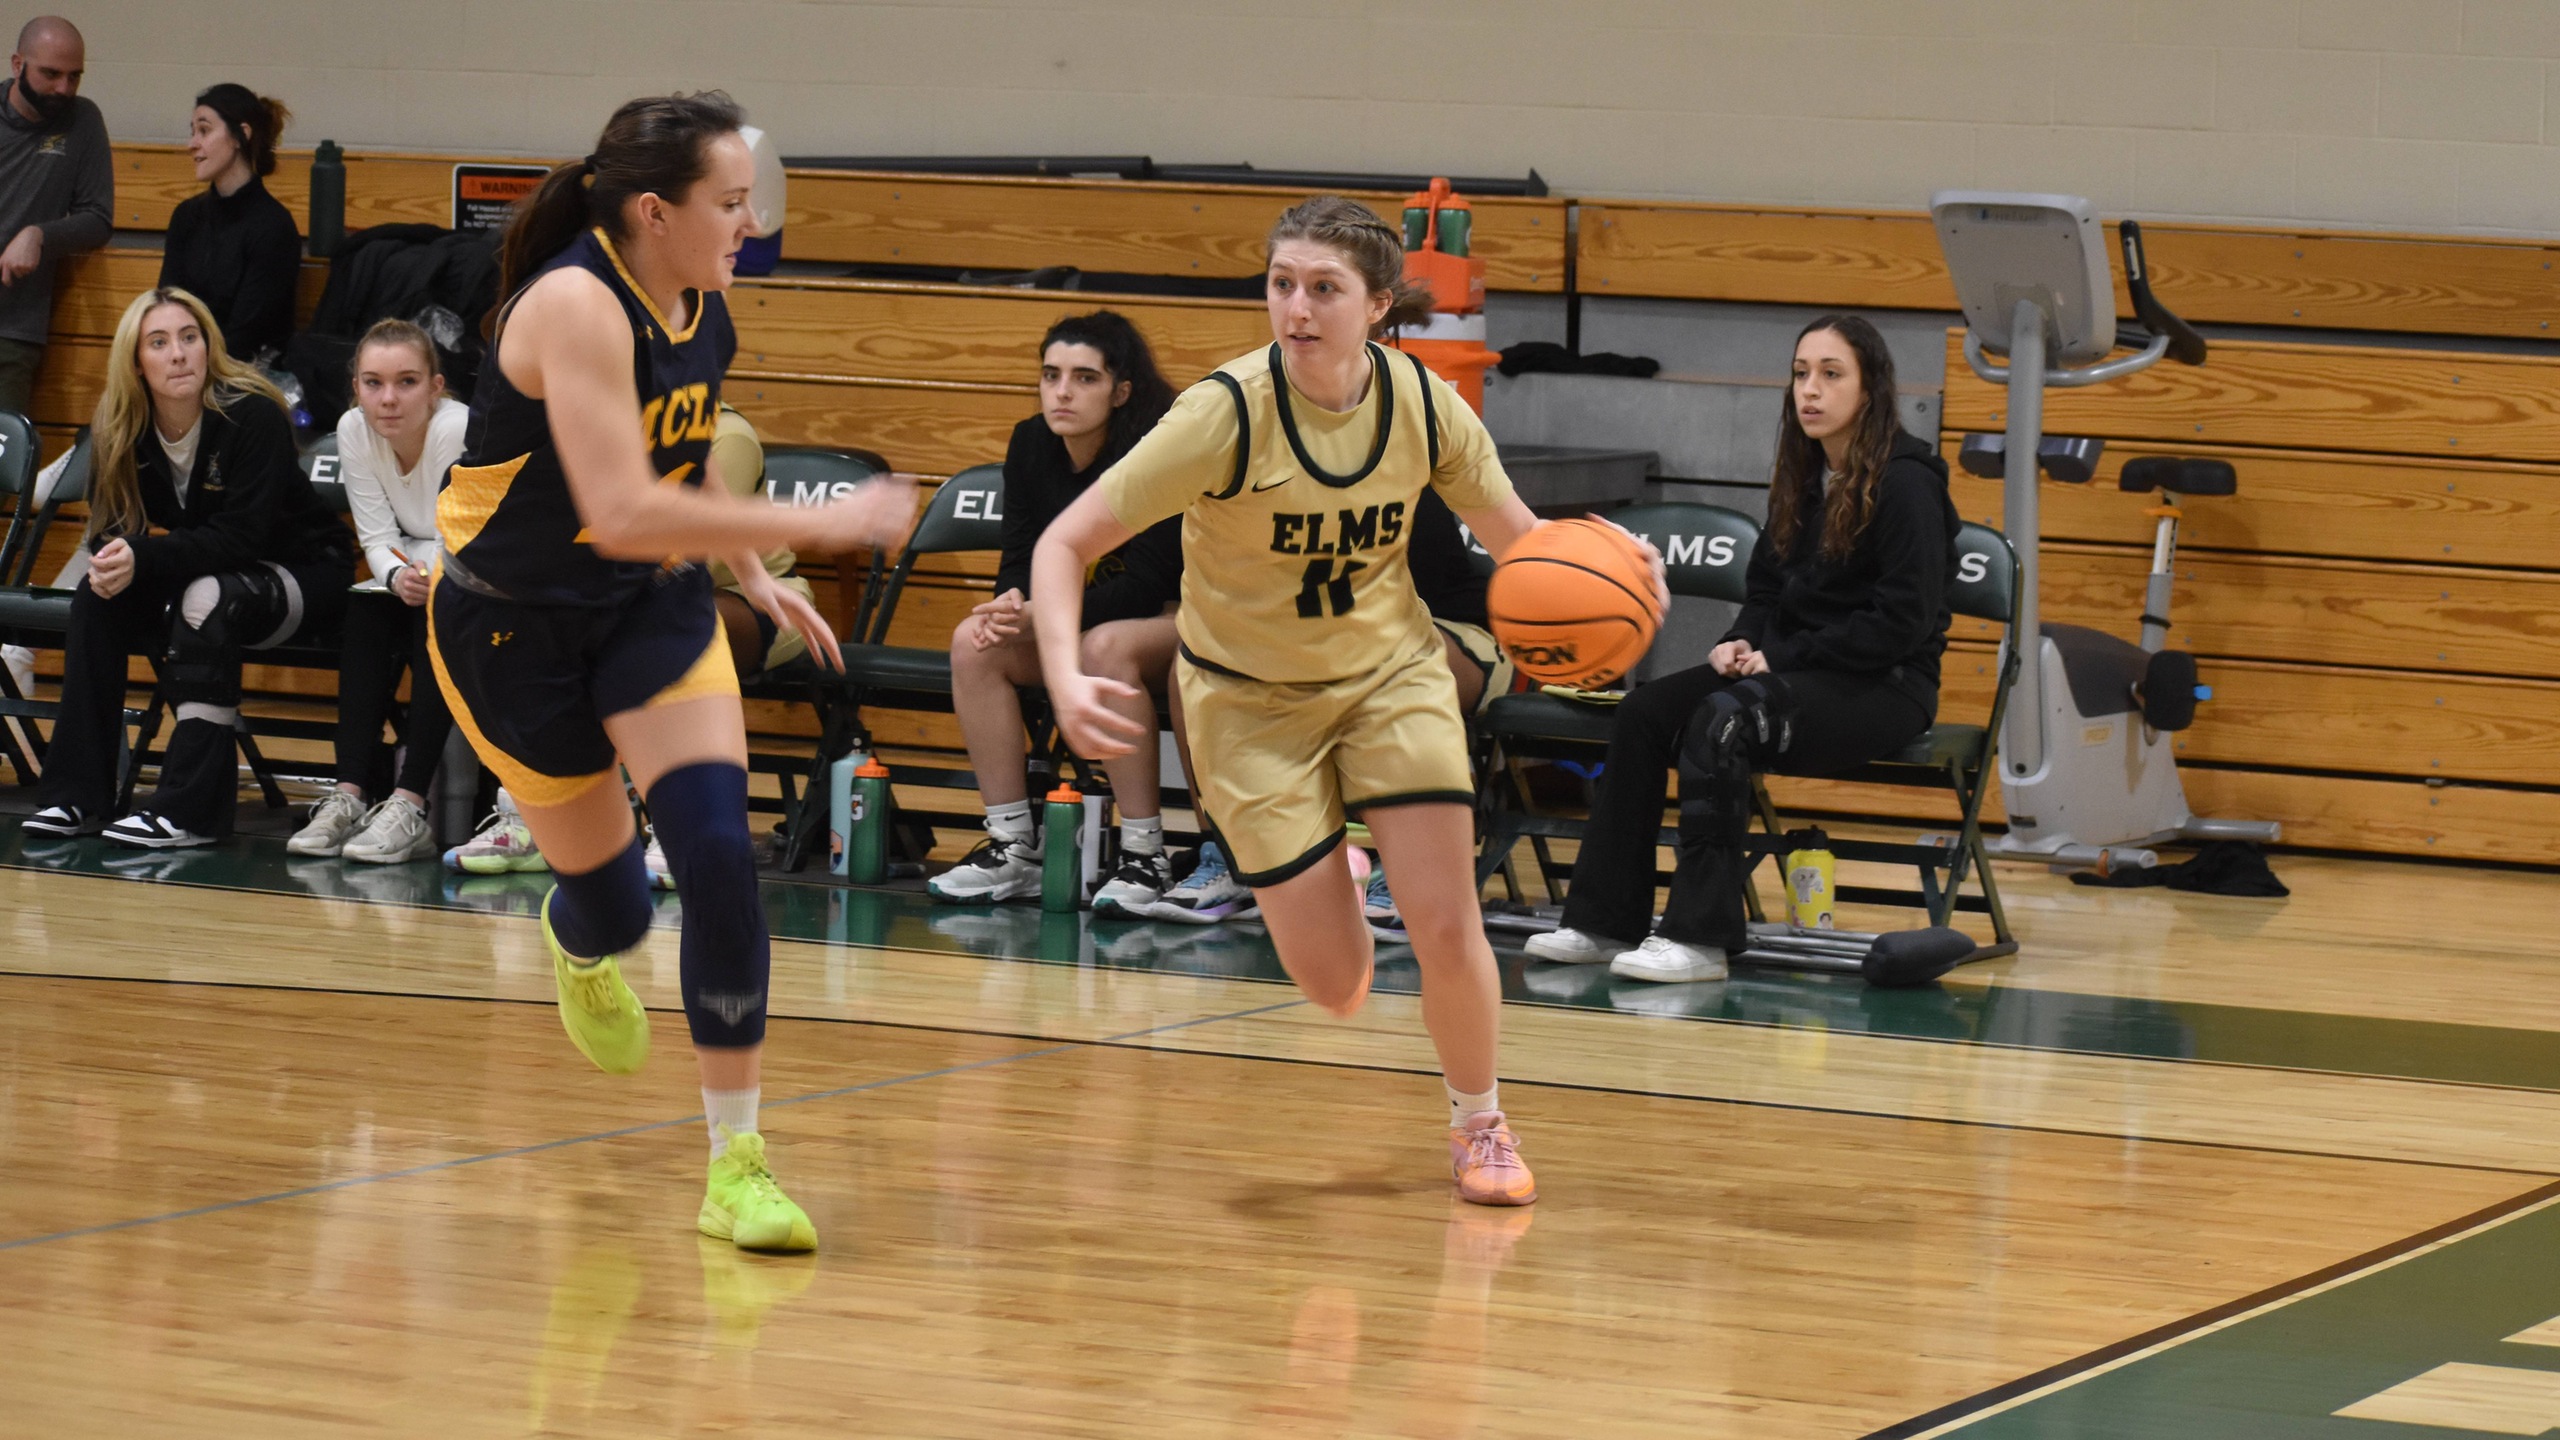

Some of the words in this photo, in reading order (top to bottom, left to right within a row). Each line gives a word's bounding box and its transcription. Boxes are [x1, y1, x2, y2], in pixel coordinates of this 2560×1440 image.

[1270, 502, 1405, 555] ELMS
[1295, 559, 1368, 618] 11
[1956, 552, 1990, 582] S
